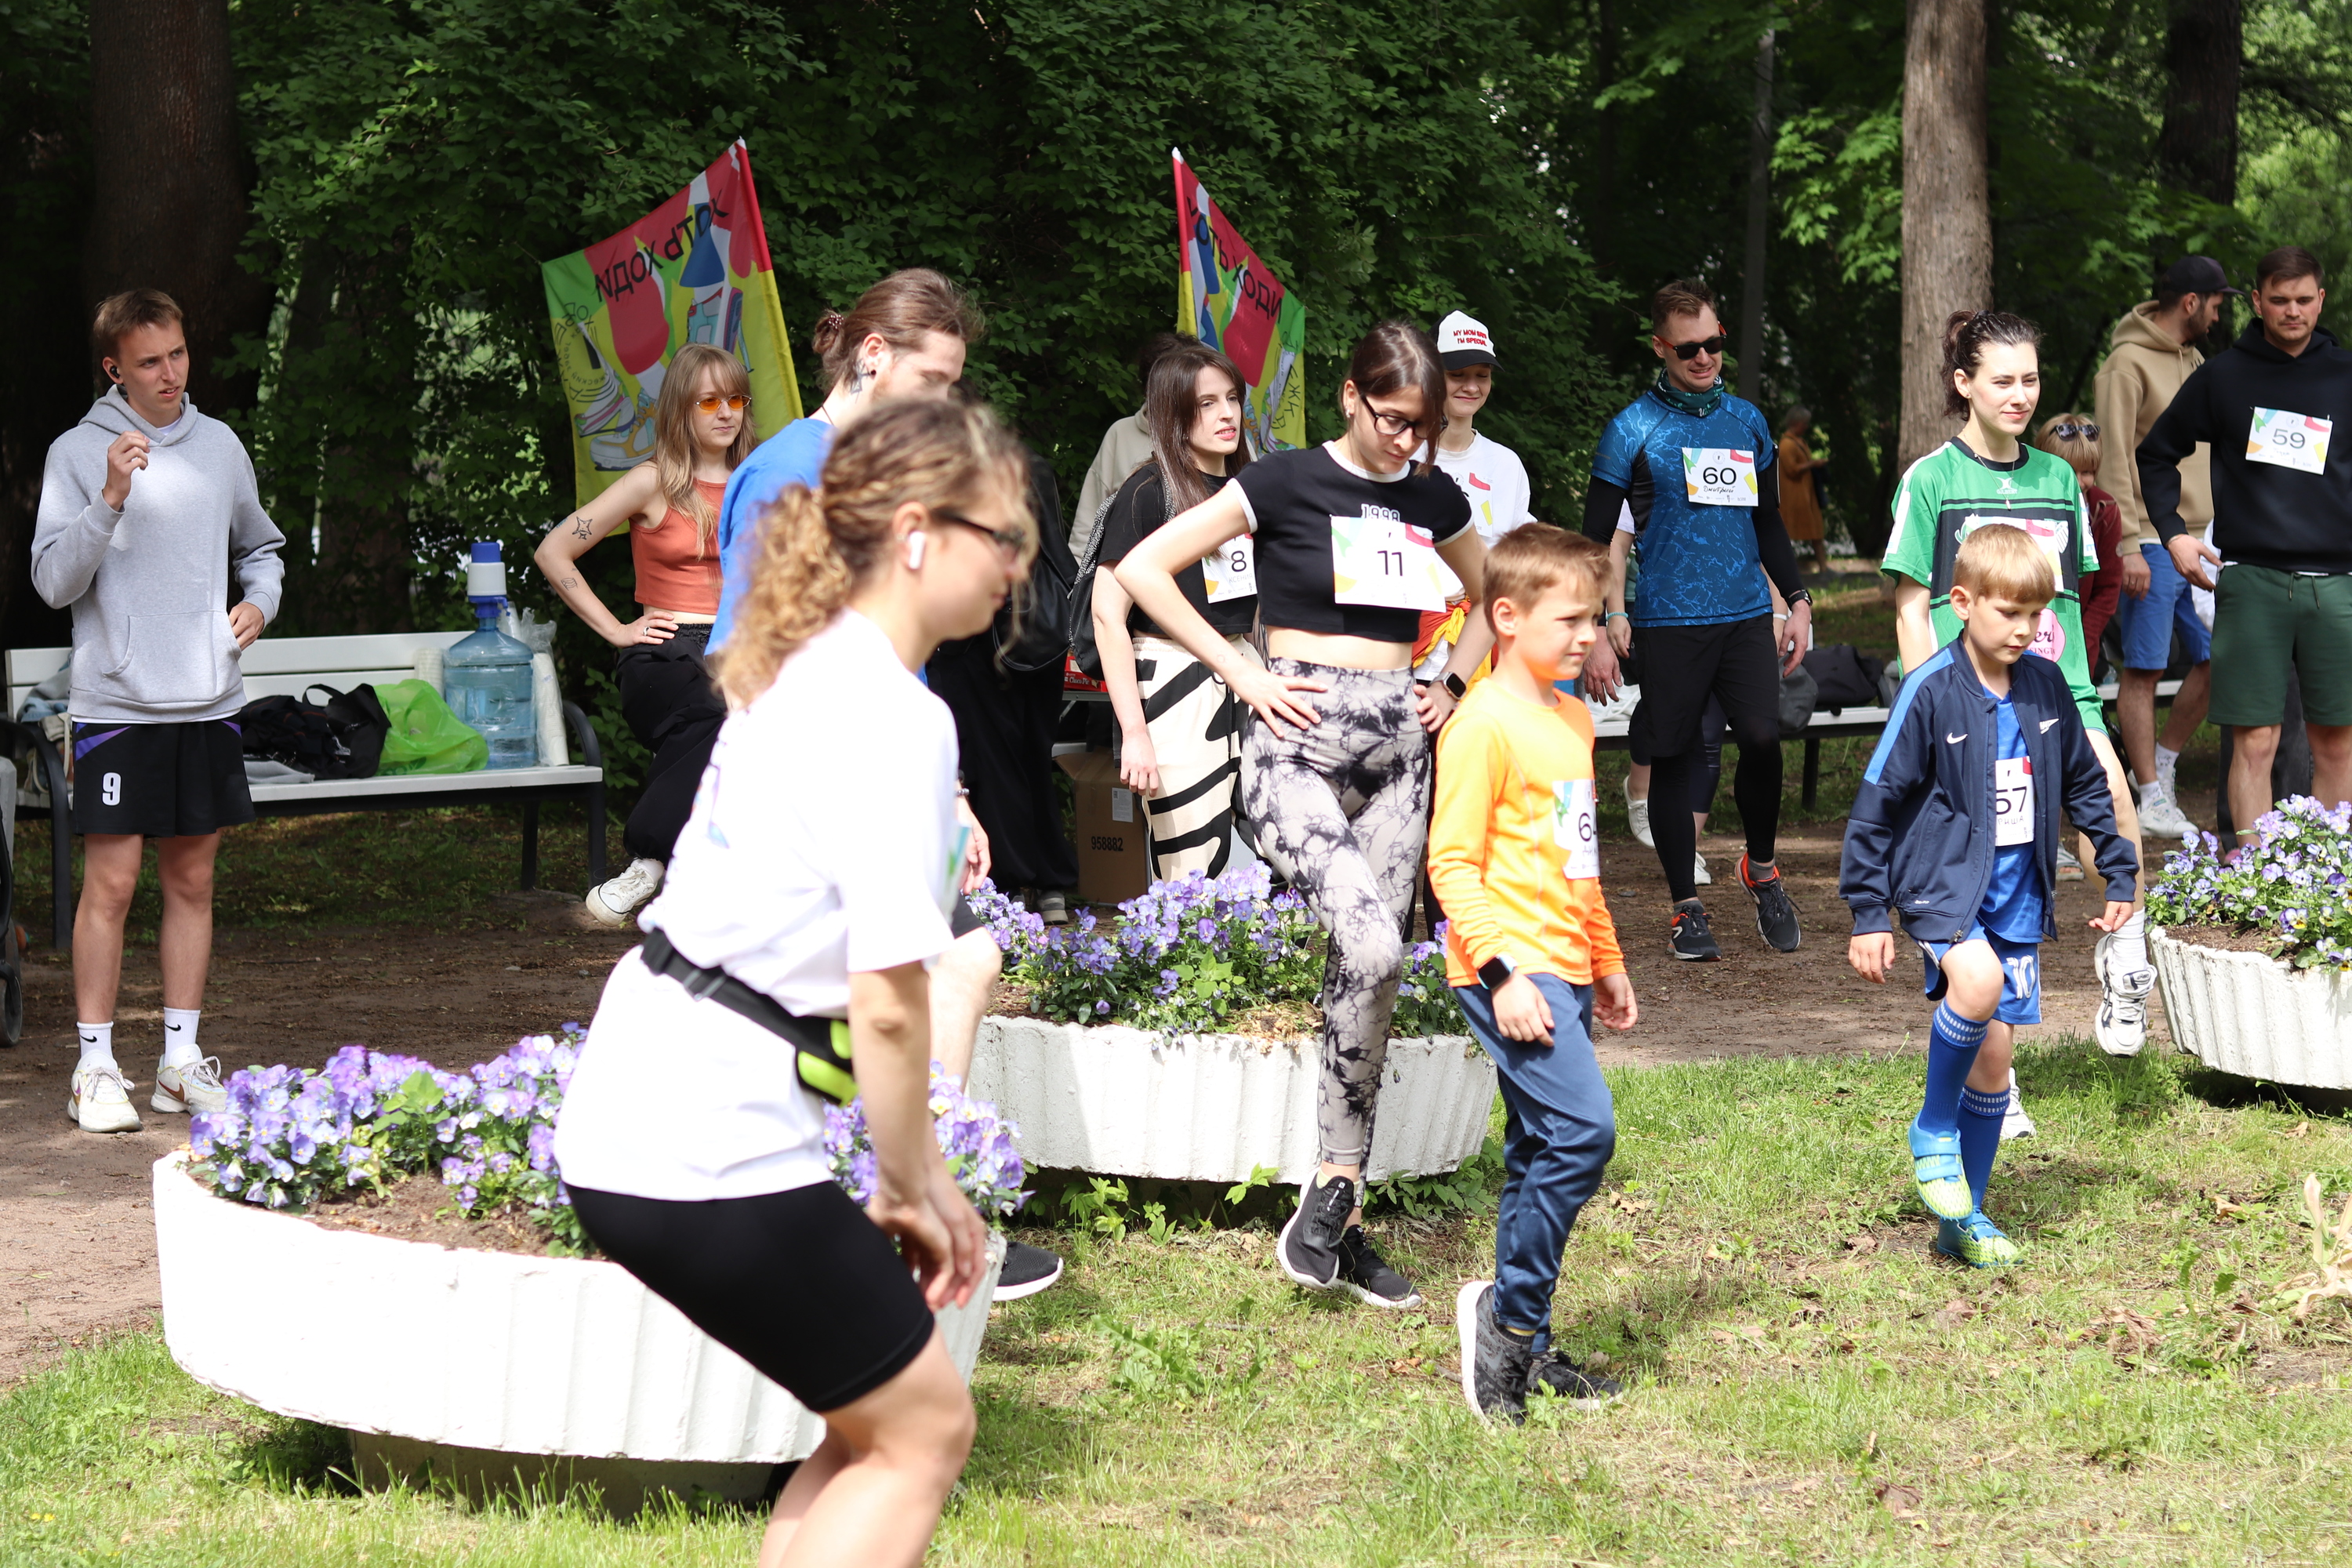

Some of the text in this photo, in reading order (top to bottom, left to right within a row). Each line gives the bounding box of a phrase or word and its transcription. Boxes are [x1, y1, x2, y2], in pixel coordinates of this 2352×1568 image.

[1232, 256, 1282, 324] ХОДИ
[2272, 428, 2306, 449] 59
[1703, 466, 1737, 485] 60
[1231, 550, 1247, 572] 8
[1377, 550, 1403, 576] 11
[102, 772, 122, 806] 9
[1996, 786, 2027, 815] 57
[1091, 836, 1123, 851] 958882
[2006, 954, 2036, 999] 10
